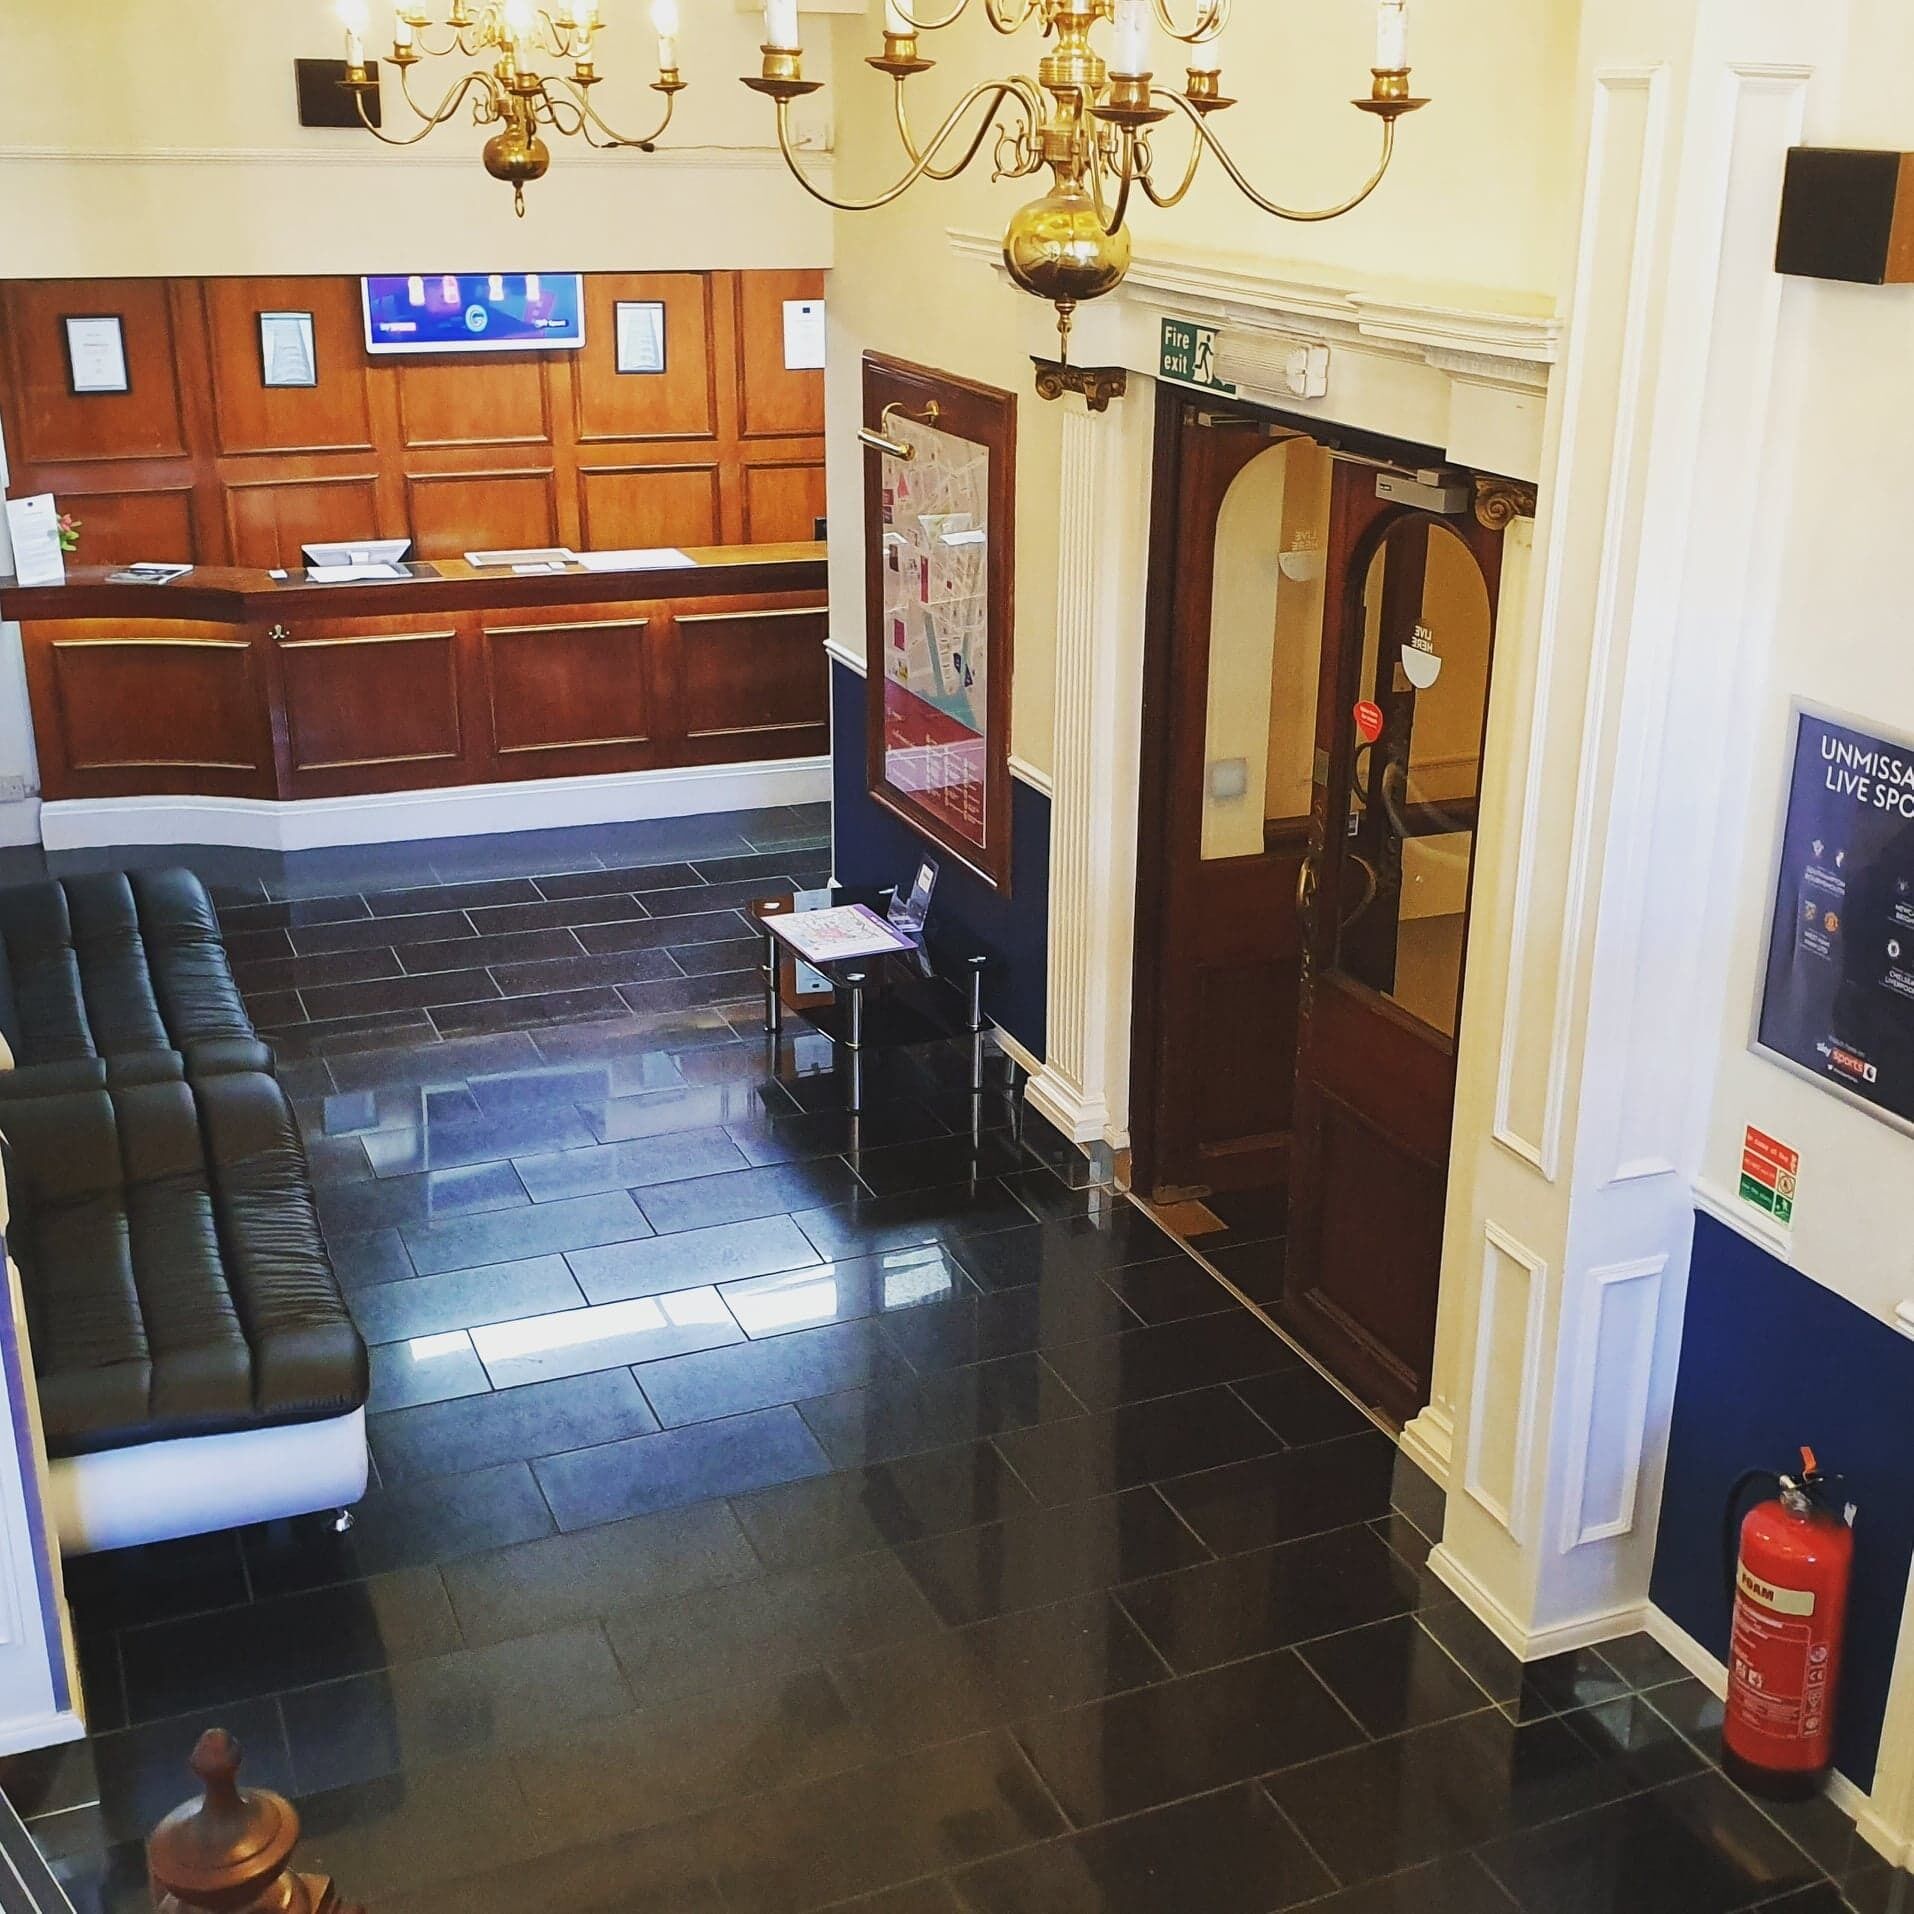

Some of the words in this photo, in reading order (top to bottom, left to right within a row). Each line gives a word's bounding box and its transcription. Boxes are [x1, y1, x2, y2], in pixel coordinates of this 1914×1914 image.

[1165, 325, 1190, 350] Fire
[1164, 355, 1188, 375] exit
[1821, 735, 1914, 790] UNMISSA
[1825, 765, 1870, 802] LIVE
[1873, 784, 1914, 818] SPO
[1741, 1573, 1775, 1602] FOAM
